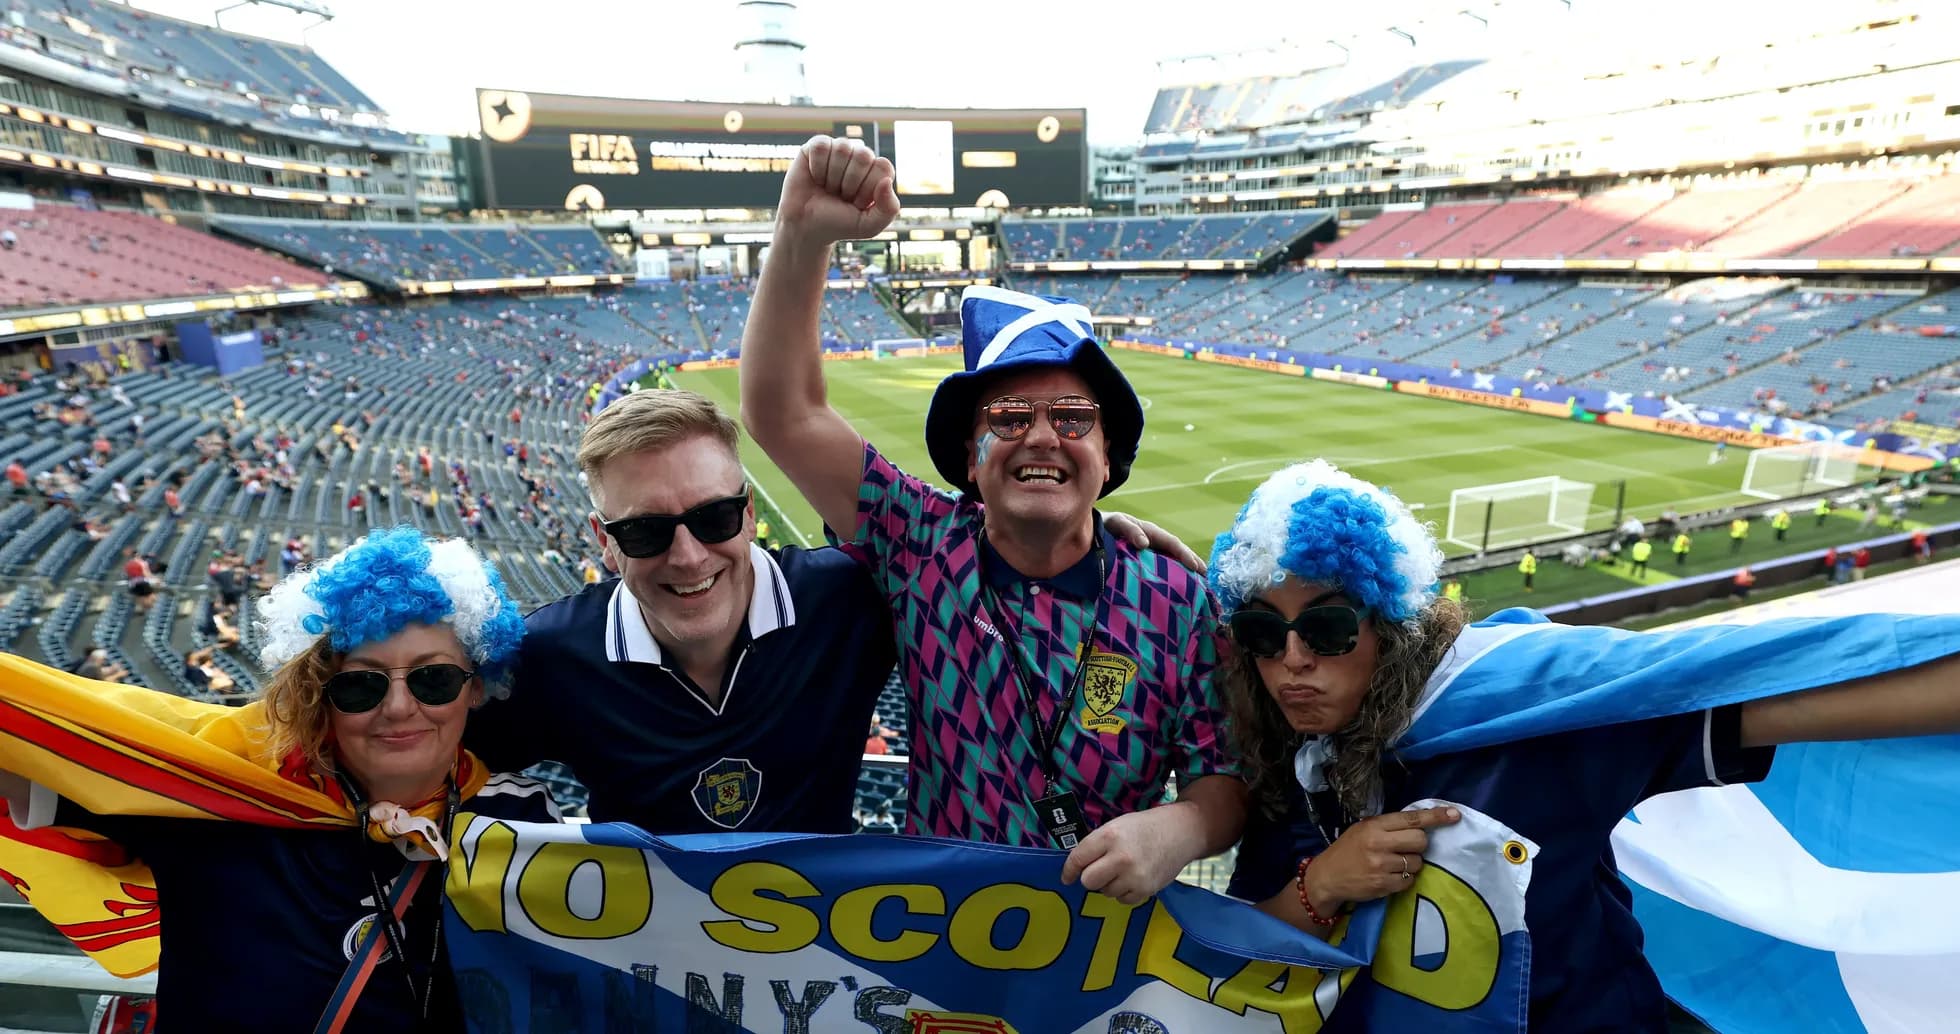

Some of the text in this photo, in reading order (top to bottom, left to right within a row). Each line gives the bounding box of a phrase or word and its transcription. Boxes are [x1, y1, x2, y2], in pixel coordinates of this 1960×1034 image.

[569, 133, 638, 160] FIFA
[973, 615, 1004, 642] umbro
[445, 812, 653, 940] NO
[700, 859, 1501, 1034] SCOTLAD
